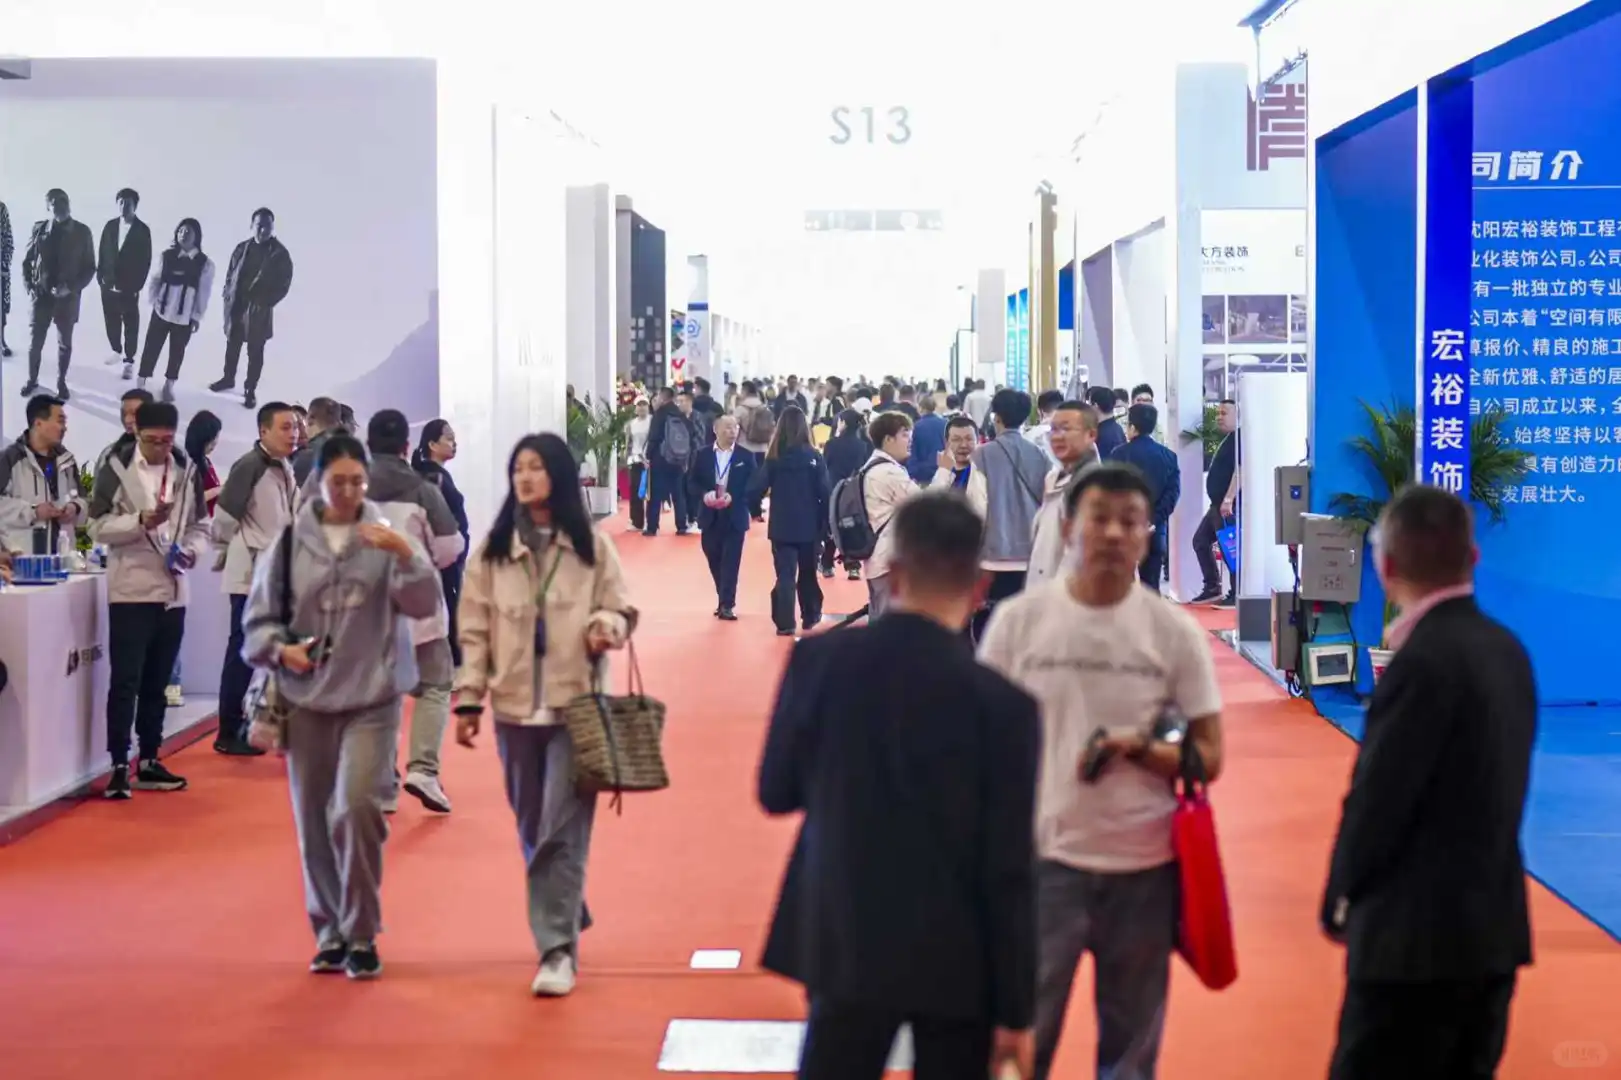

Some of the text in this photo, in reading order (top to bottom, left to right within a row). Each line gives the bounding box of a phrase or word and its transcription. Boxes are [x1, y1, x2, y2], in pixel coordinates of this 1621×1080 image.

[829, 105, 912, 146] S13
[1472, 150, 1584, 181] 司简介
[1472, 219, 1621, 239] 阳宏裕装饰工程
[1430, 328, 1465, 494] 宏裕装饰
[1523, 455, 1621, 474] 具有创造力
